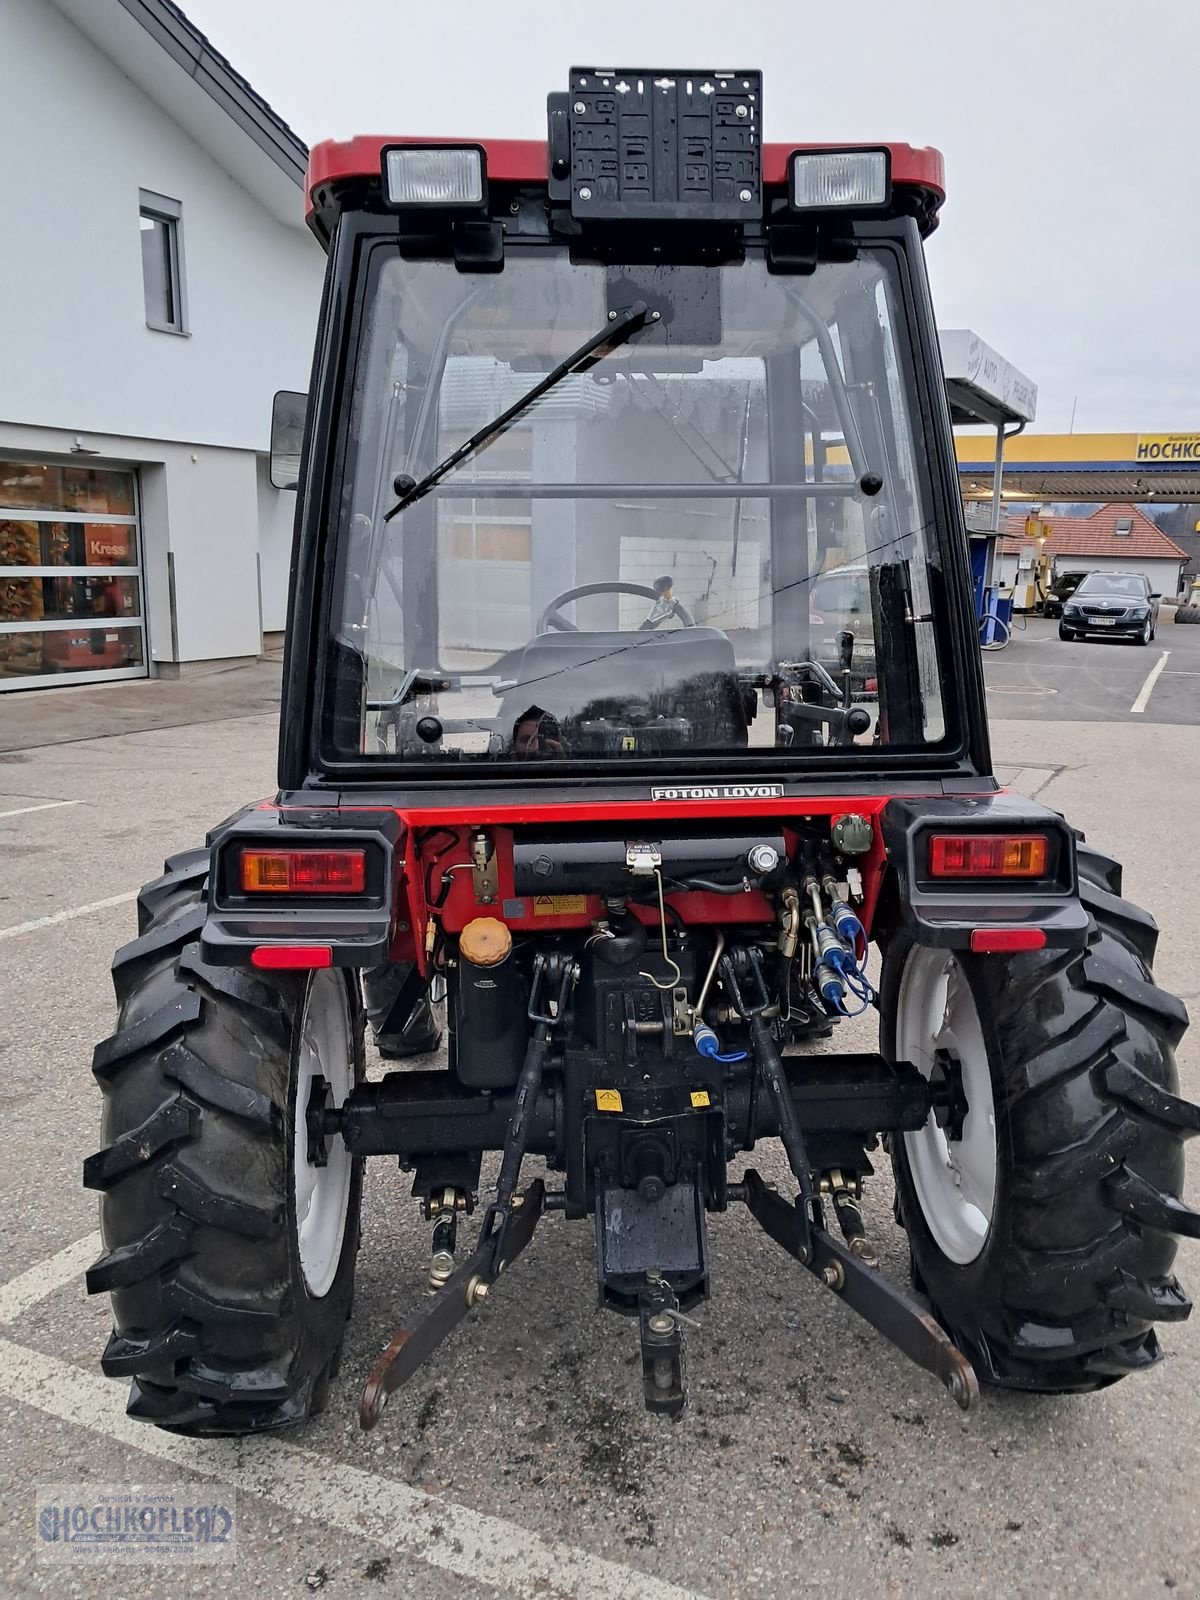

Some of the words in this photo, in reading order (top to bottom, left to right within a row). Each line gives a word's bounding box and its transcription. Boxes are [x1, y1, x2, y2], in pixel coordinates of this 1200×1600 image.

[90, 540, 126, 555] Kress
[654, 788, 718, 799] FOTON
[723, 786, 781, 797] LOVOL
